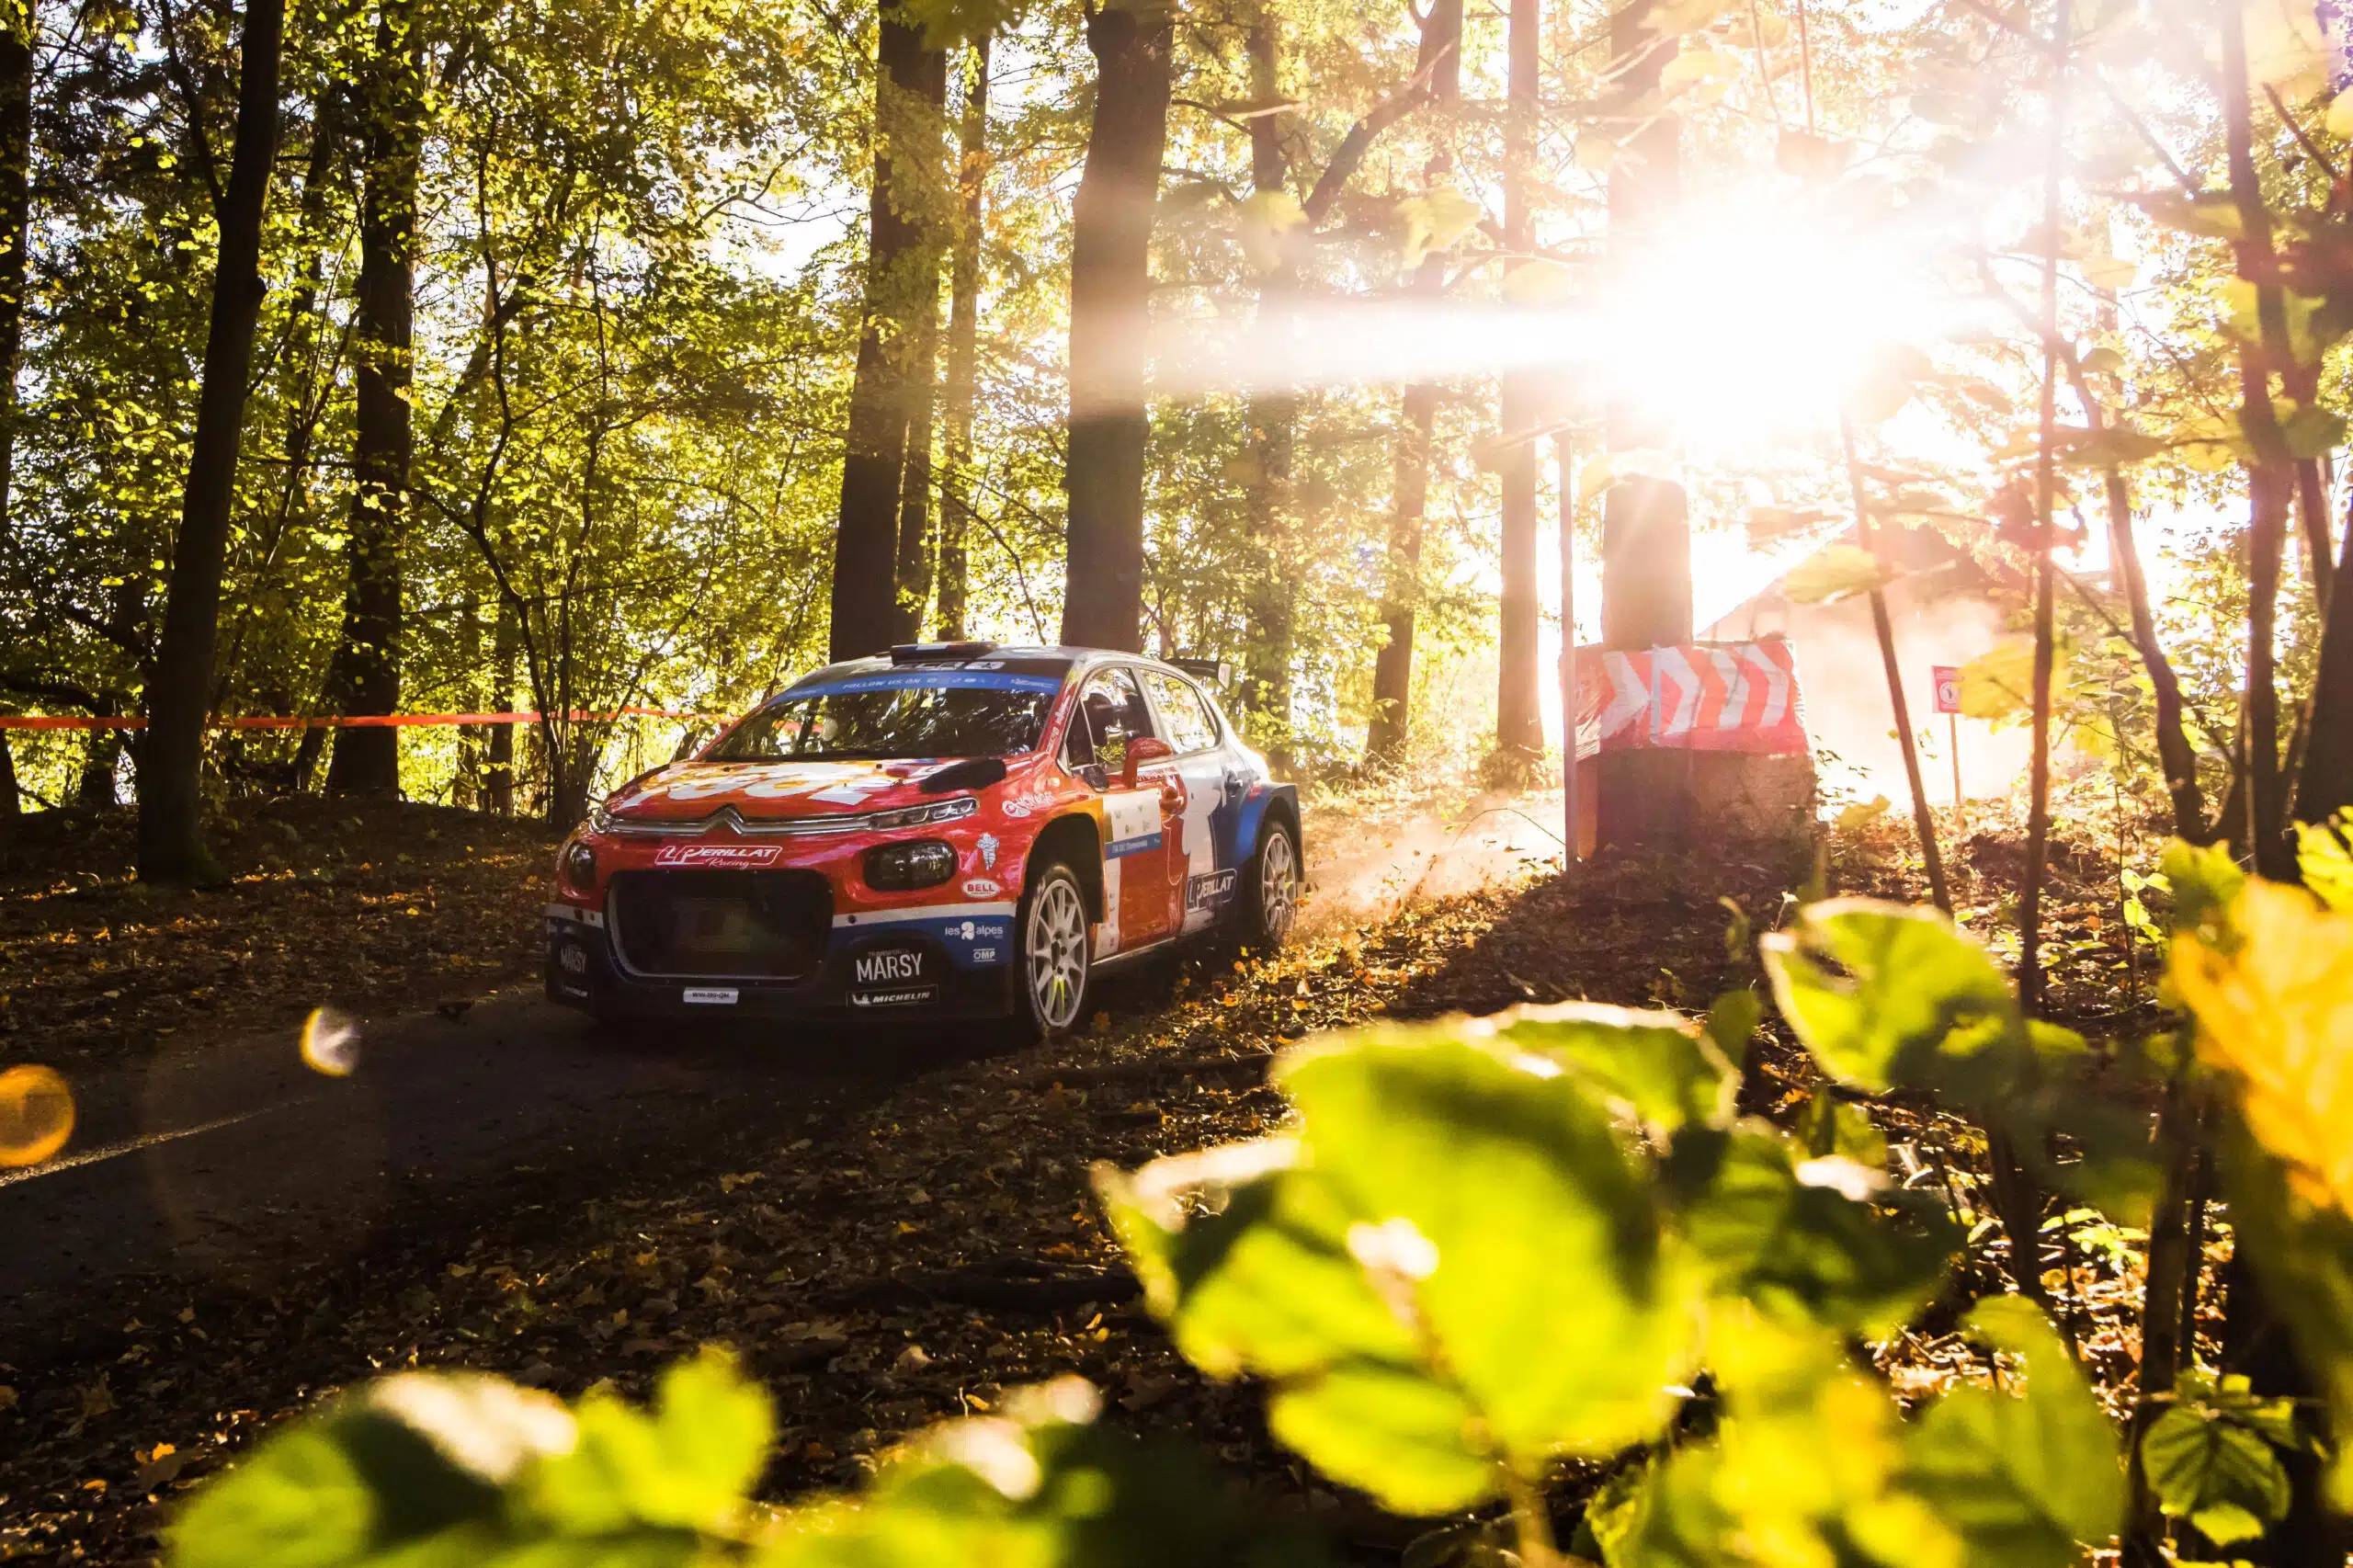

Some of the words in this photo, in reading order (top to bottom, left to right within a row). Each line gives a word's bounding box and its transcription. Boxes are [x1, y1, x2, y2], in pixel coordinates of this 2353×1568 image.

[842, 679, 885, 689] FOLLOW
[887, 678, 902, 687] US
[904, 677, 922, 686] ON
[704, 858, 750, 870] Racing
[967, 883, 995, 892] BELL
[945, 926, 961, 936] les
[961, 921, 975, 940] 2
[975, 925, 1004, 937] alpes
[972, 950, 996, 960] OMP
[856, 952, 923, 983] MARSY
[872, 991, 931, 1004] MICHELIN
